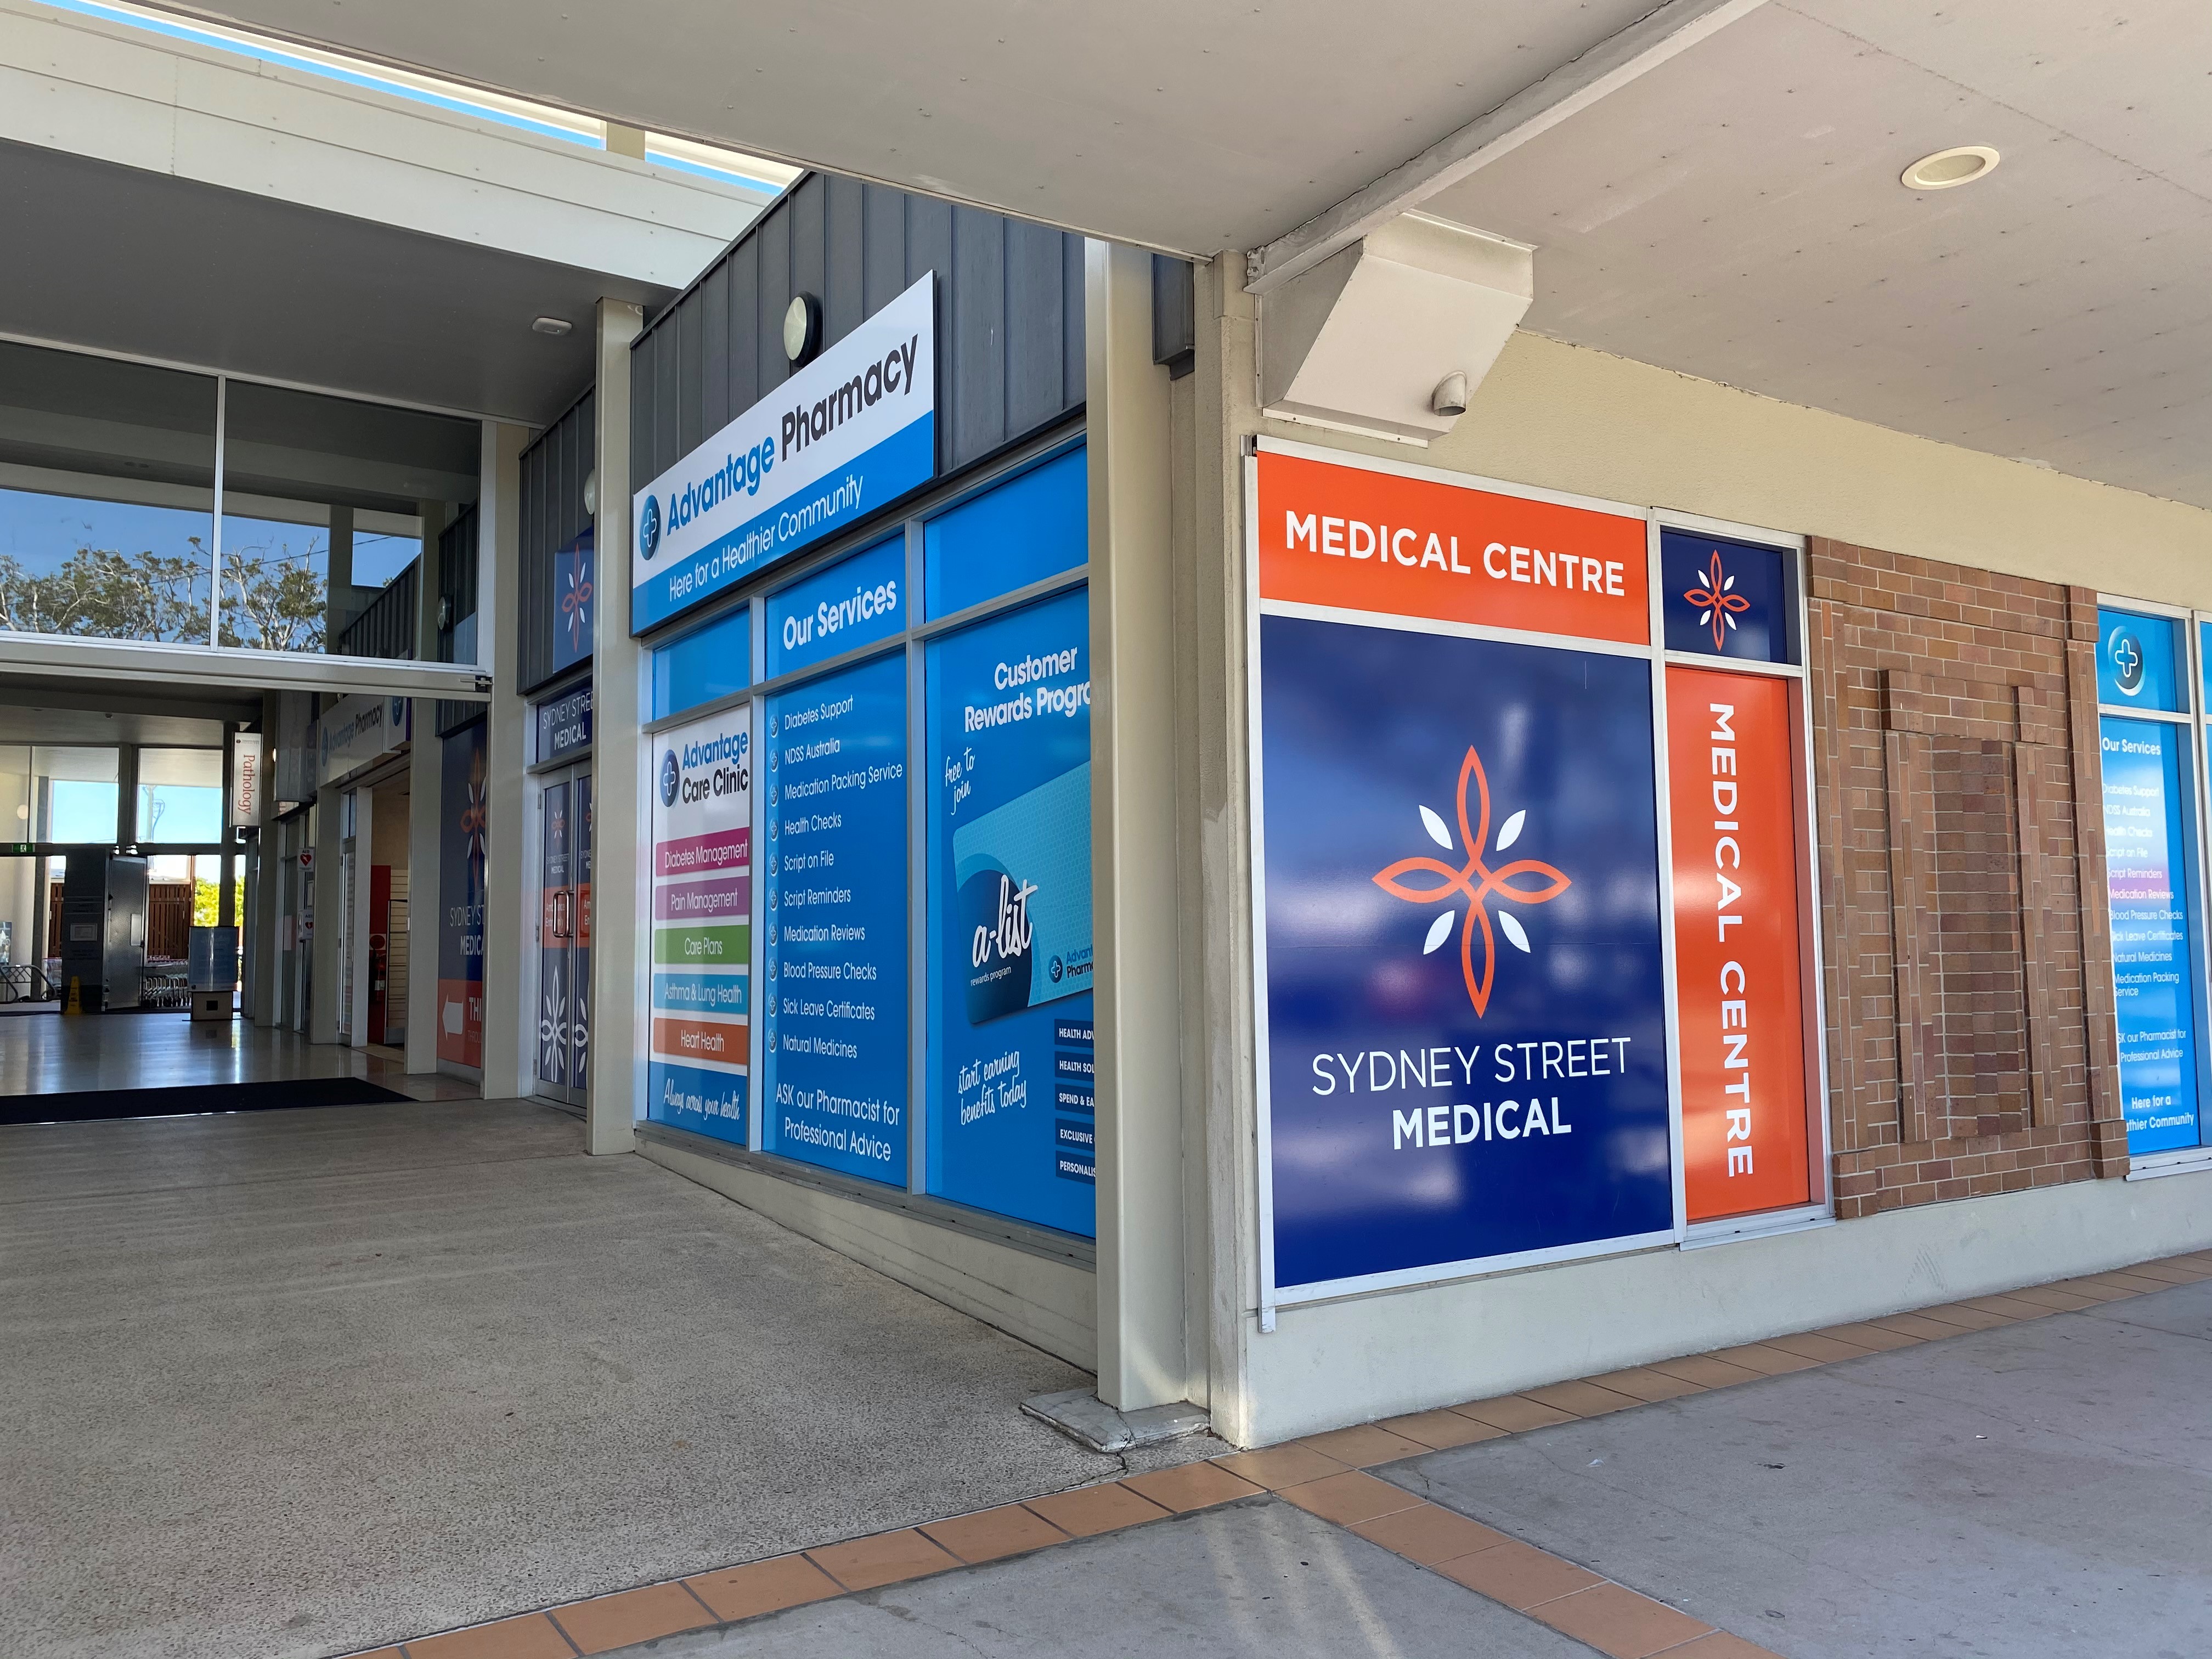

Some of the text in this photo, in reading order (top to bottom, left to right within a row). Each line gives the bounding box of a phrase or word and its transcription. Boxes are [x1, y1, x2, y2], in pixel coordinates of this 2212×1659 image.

[667, 334, 918, 536] Advantage Pharmacy
[670, 474, 864, 602] Here for a Healthier Community
[1285, 510, 1625, 597] MEDICAL CENTRE
[783, 580, 897, 650] Our Services
[994, 647, 1077, 690] Customer
[543, 691, 593, 730] SYDNEY STREE
[785, 695, 854, 731] Diabetes Support
[964, 681, 1091, 733] Rewards Progra
[355, 702, 383, 737] Pharmacy
[554, 721, 586, 751] MEDICAL
[2102, 737, 2161, 755] Our Services
[682, 732, 748, 770] Advantage
[785, 737, 840, 765] NDSS Australia
[945, 747, 975, 787] free to
[238, 754, 256, 815] Pathology
[682, 764, 748, 804] Care Clinic
[785, 762, 903, 800] Medication Packing Service
[2134, 785, 2160, 798] Support
[951, 780, 971, 815] join
[785, 811, 842, 836] Health Checks
[665, 838, 748, 868] Diabetes Management
[784, 850, 834, 873] Script on File
[2127, 868, 2163, 879] Reminders
[671, 888, 738, 913] Pain Management
[784, 886, 851, 909] Script Reminders
[2148, 889, 2174, 900] Reviews
[450, 905, 476, 927] SYDNEY
[972, 874, 1038, 968] a-list
[2111, 909, 2183, 920] Blood Pressure Checks
[784, 924, 865, 942] Medication Reviews
[1709, 702, 1754, 1178] MEDICAL CENTRE
[2147, 930, 2183, 941] Certificates
[460, 935, 484, 956] MEDIC
[684, 937, 723, 955] Care Plans
[1066, 944, 1093, 964] Advant
[2114, 951, 2172, 963] Natural Medicines
[783, 962, 877, 980] Blood Pressure Checks
[970, 966, 1012, 986] rewards program
[1066, 961, 1093, 978] Pharm
[2153, 972, 2180, 984] Packing
[664, 983, 742, 1007] Asthma & Lung Health
[2115, 986, 2139, 997] Service
[469, 996, 482, 1022] THI
[783, 997, 875, 1020] Sick Leave Certificates
[680, 1029, 725, 1052] Heart Health
[1059, 1028, 1081, 1039] HEALTH
[2118, 1029, 2186, 1043] SK our Pharmacist for
[783, 1034, 857, 1059] Natural Medicines
[2120, 1047, 2183, 1063] Professional Advice
[958, 1051, 1020, 1094] start earning
[1059, 1060, 1095, 1074] HEALTH SOL
[1311, 1036, 1633, 1096] SYDNEY STREET
[663, 1077, 684, 1115] Always
[703, 1098, 719, 1121] your
[720, 1090, 740, 1120] health
[776, 1083, 900, 1126] ASK our Pharmacist for
[961, 1075, 1026, 1125] benefits today
[1059, 1092, 1079, 1105] SPEND
[1080, 1096, 1085, 1105] &
[2131, 1094, 2172, 1110] Here for a
[1392, 1097, 1572, 1150] MEDICAL
[2149, 1111, 2194, 1128] Community
[785, 1116, 891, 1161] Professional Advice
[1060, 1128, 1093, 1144] EXCLUSIVE
[1059, 1160, 1096, 1177] PERSONALIS
